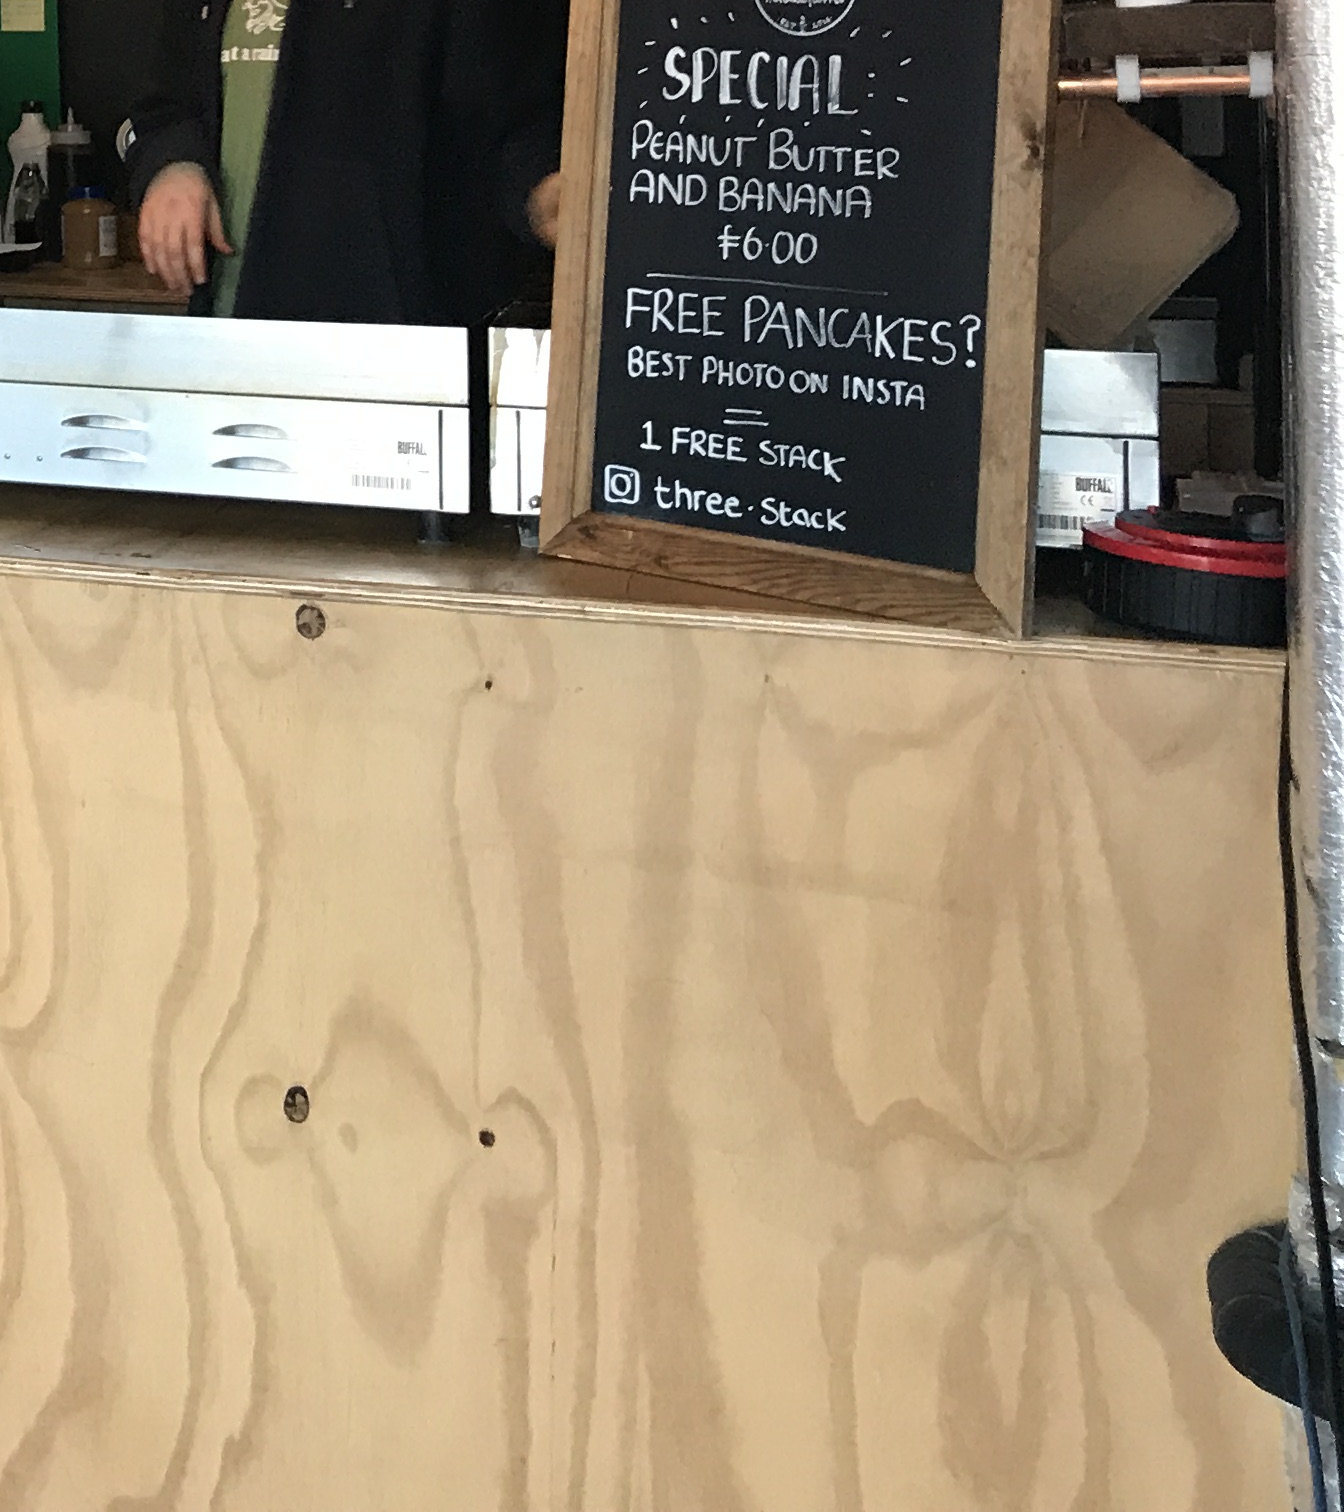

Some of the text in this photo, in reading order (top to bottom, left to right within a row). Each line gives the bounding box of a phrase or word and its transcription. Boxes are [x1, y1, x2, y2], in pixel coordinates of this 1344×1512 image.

[632, 119, 900, 180] PEANUT BUTTER
[629, 169, 872, 219] AND BANANA
[625, 288, 982, 369] FREE PANCAKES?
[627, 346, 925, 411] BEST PHOTO ON INSTA
[397, 440, 428, 456] BUFFAL
[640, 420, 846, 483] 1 FREE STACK
[1075, 476, 1113, 494] BUFFAL
